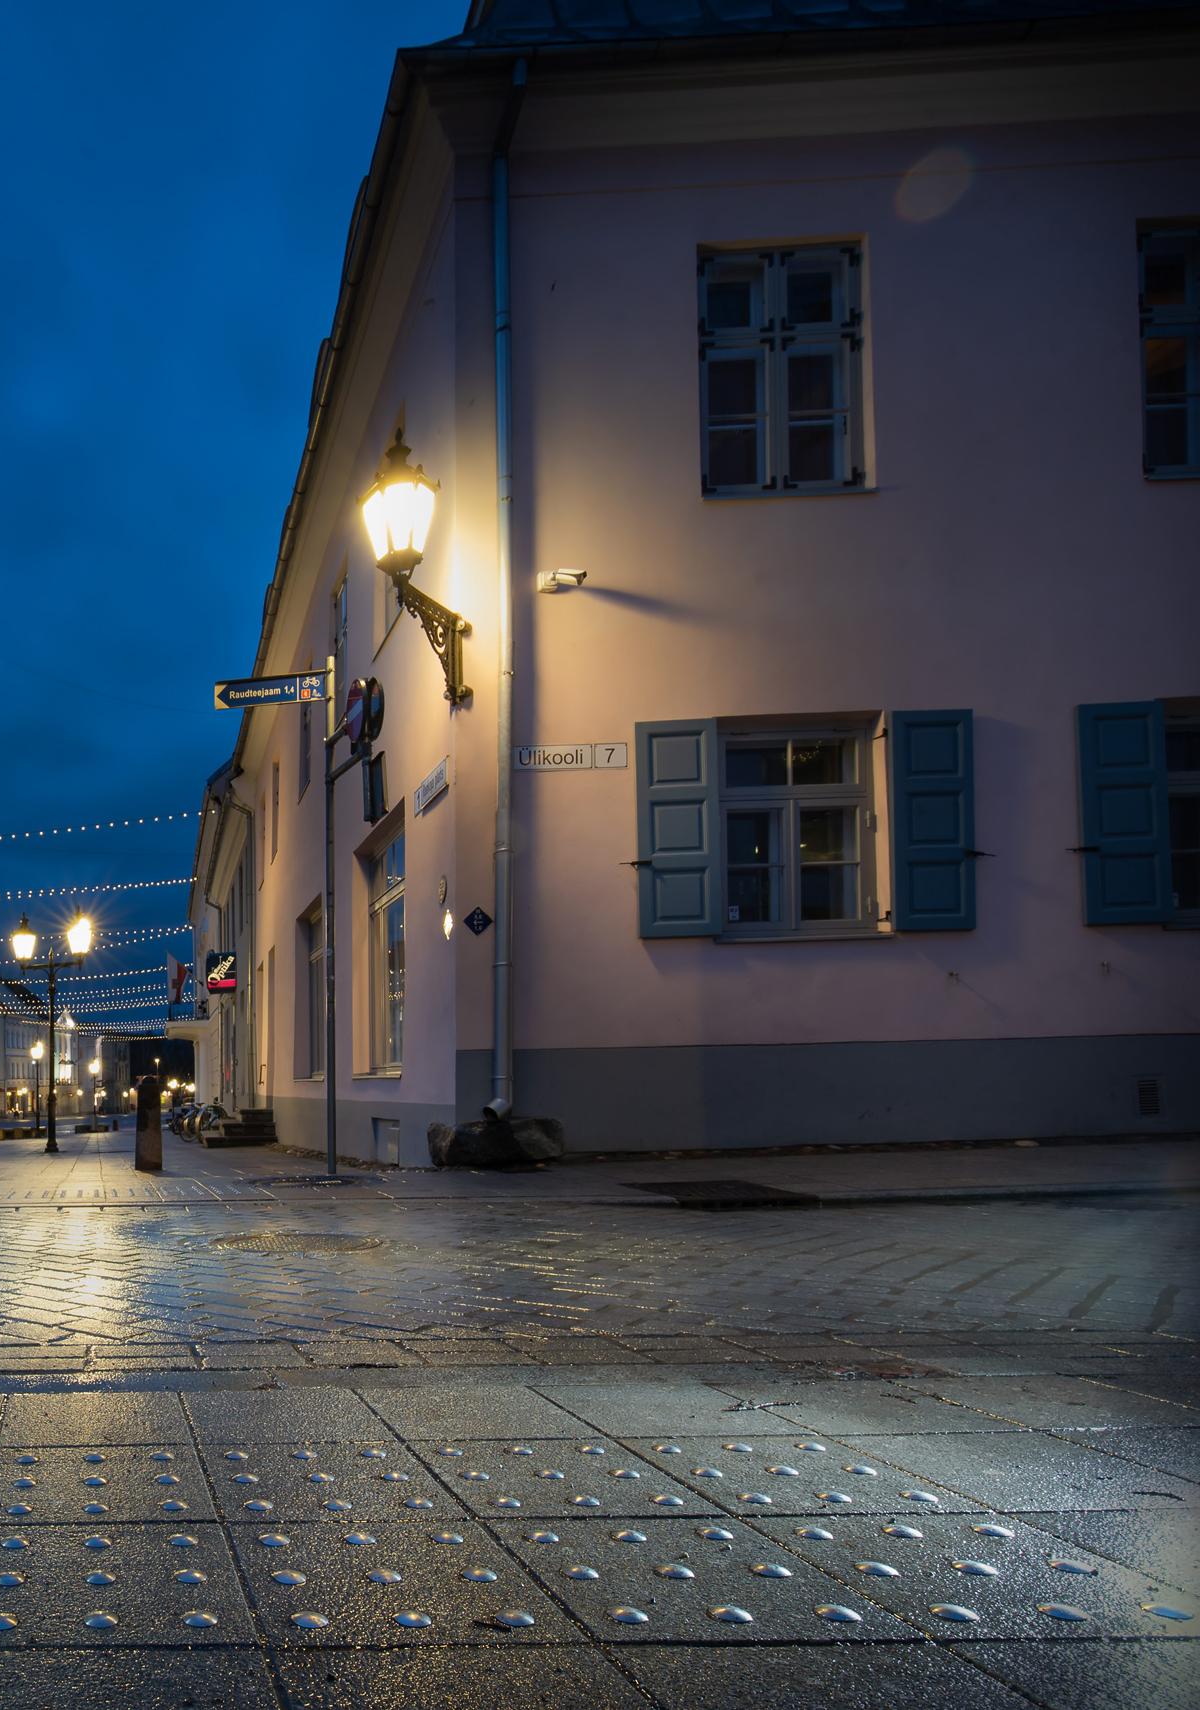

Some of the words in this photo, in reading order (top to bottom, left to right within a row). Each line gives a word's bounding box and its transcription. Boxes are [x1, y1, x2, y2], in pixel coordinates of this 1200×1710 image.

[229, 687, 281, 700] Raudteejaam
[519, 747, 583, 766] Ülikooli
[605, 748, 615, 763] 7
